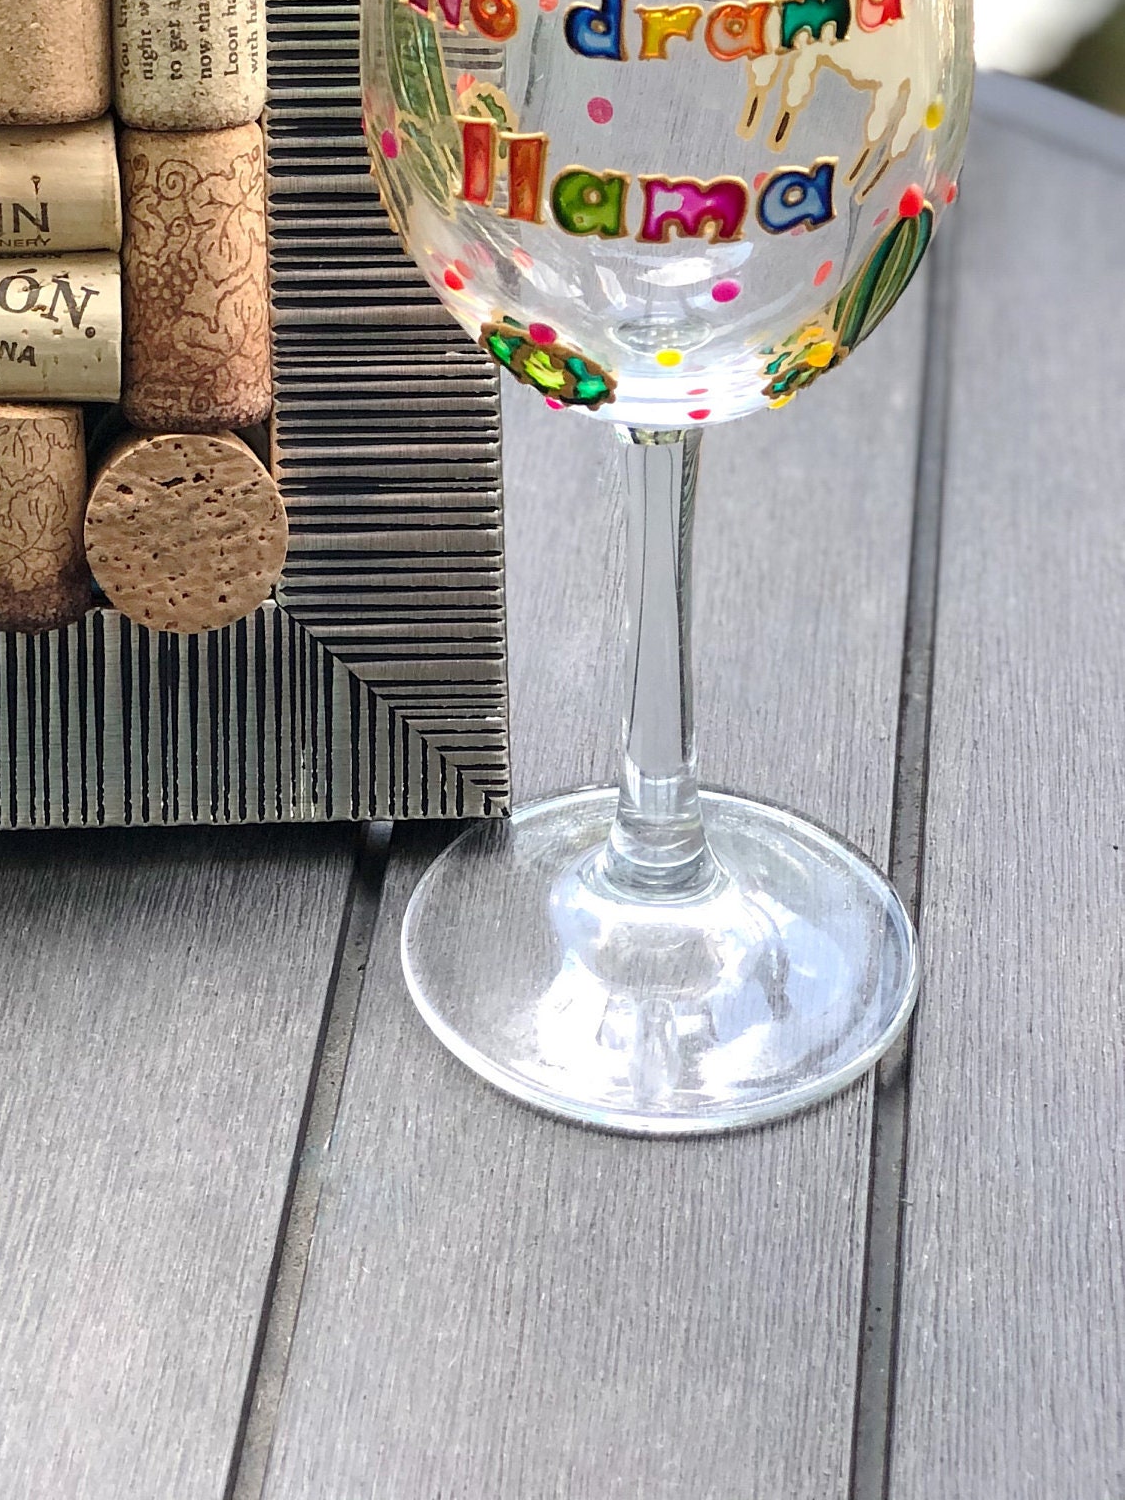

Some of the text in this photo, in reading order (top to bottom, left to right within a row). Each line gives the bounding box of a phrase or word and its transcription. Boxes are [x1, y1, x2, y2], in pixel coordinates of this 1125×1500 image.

[137, 29, 158, 80] night
[169, 19, 188, 52] get
[223, 25, 240, 77] Loon
[245, 29, 259, 75] with
[170, 54, 183, 81] to
[199, 38, 213, 80] now
[451, 114, 840, 245] llama
